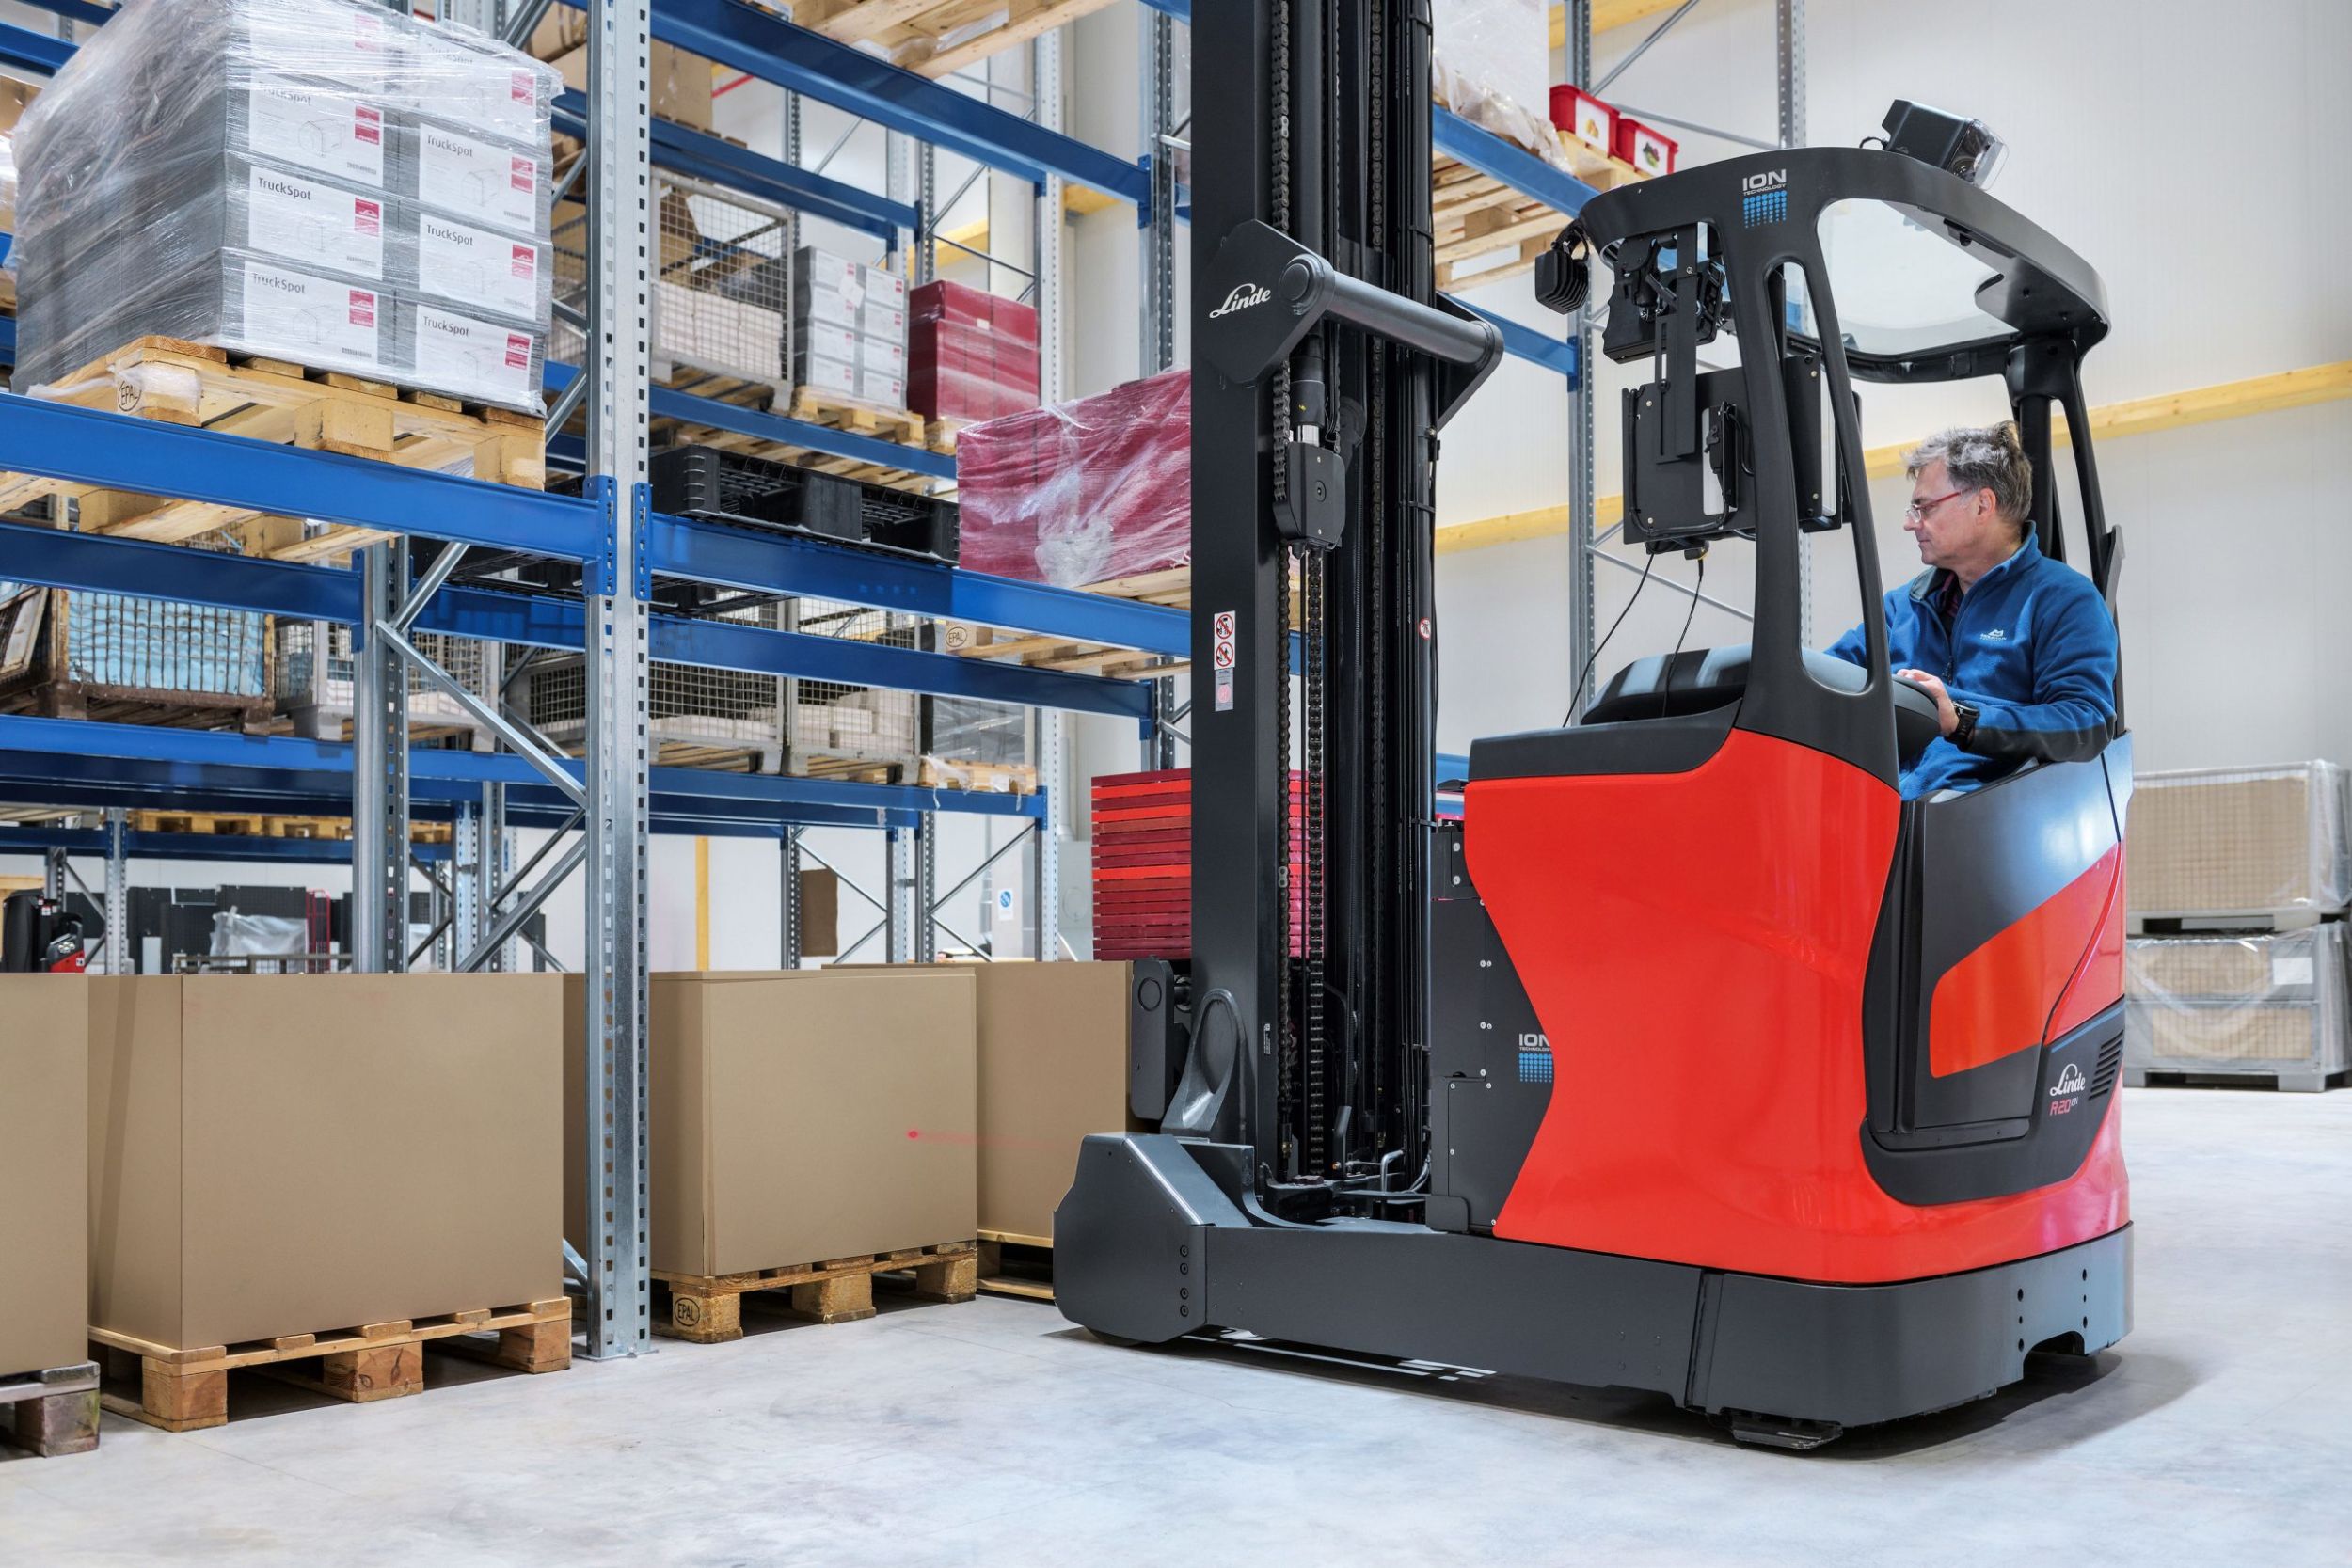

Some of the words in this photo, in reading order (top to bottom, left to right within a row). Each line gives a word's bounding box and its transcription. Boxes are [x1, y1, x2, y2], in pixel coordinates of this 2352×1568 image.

[427, 135, 474, 158] TruckSpot
[258, 177, 311, 200] TruckSpot
[1742, 168, 1787, 192] ION
[1743, 183, 1787, 196] TECHNOLOGY
[426, 224, 474, 246] TruckSpot
[253, 272, 306, 294] TruckSpot
[1209, 282, 1272, 319] Linde
[423, 315, 469, 338] TruckSpot
[120, 384, 138, 405] EPAL
[948, 631, 964, 644] EPAL
[2049, 1063, 2086, 1097] Linde
[677, 1302, 695, 1322] EPAL
